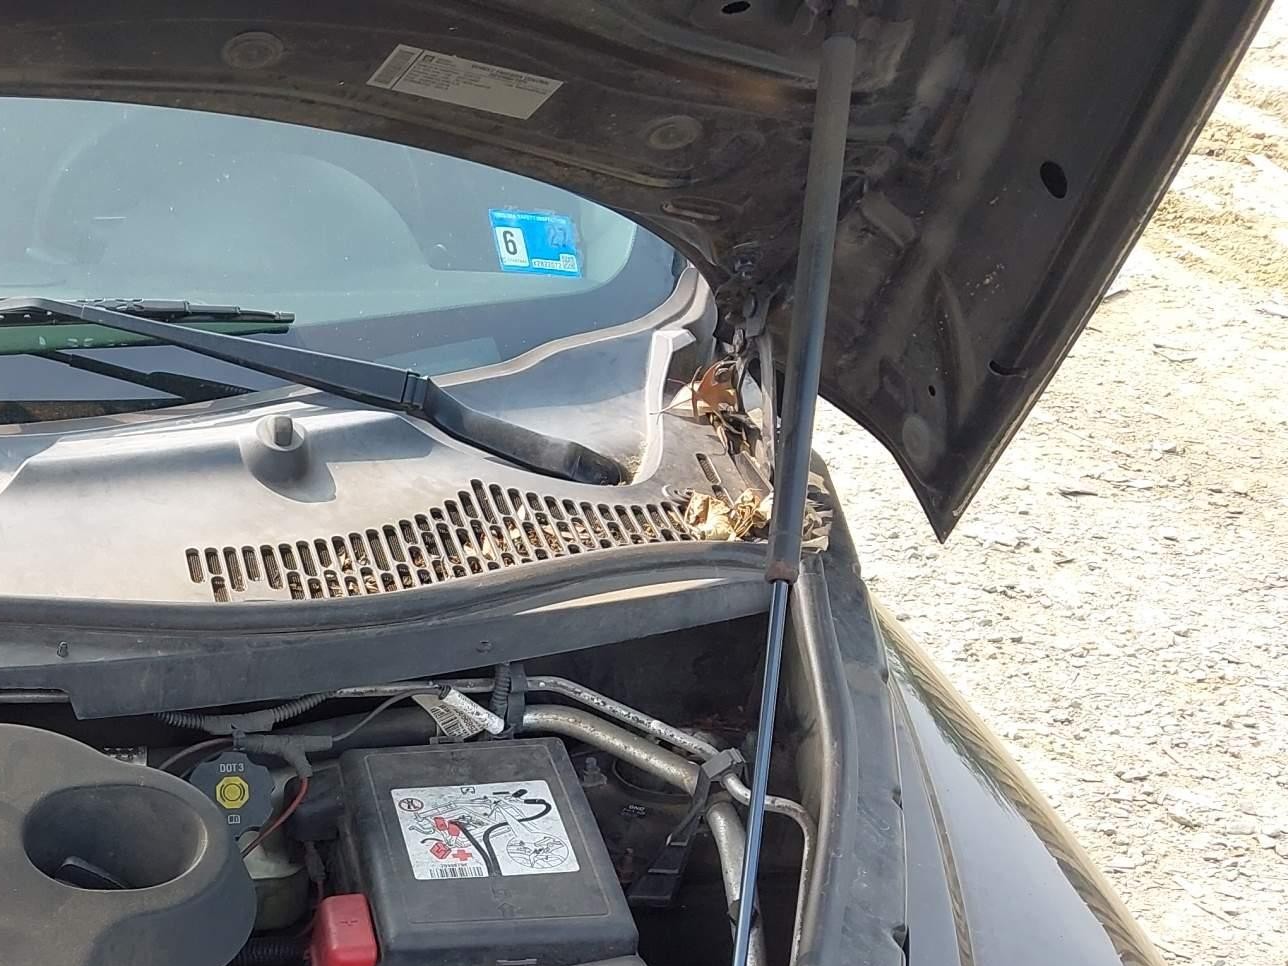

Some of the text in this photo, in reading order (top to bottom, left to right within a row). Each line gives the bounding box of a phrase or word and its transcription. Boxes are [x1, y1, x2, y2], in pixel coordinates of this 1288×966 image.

[502, 230, 518, 256] 6
[219, 763, 245, 773] DOT 3
